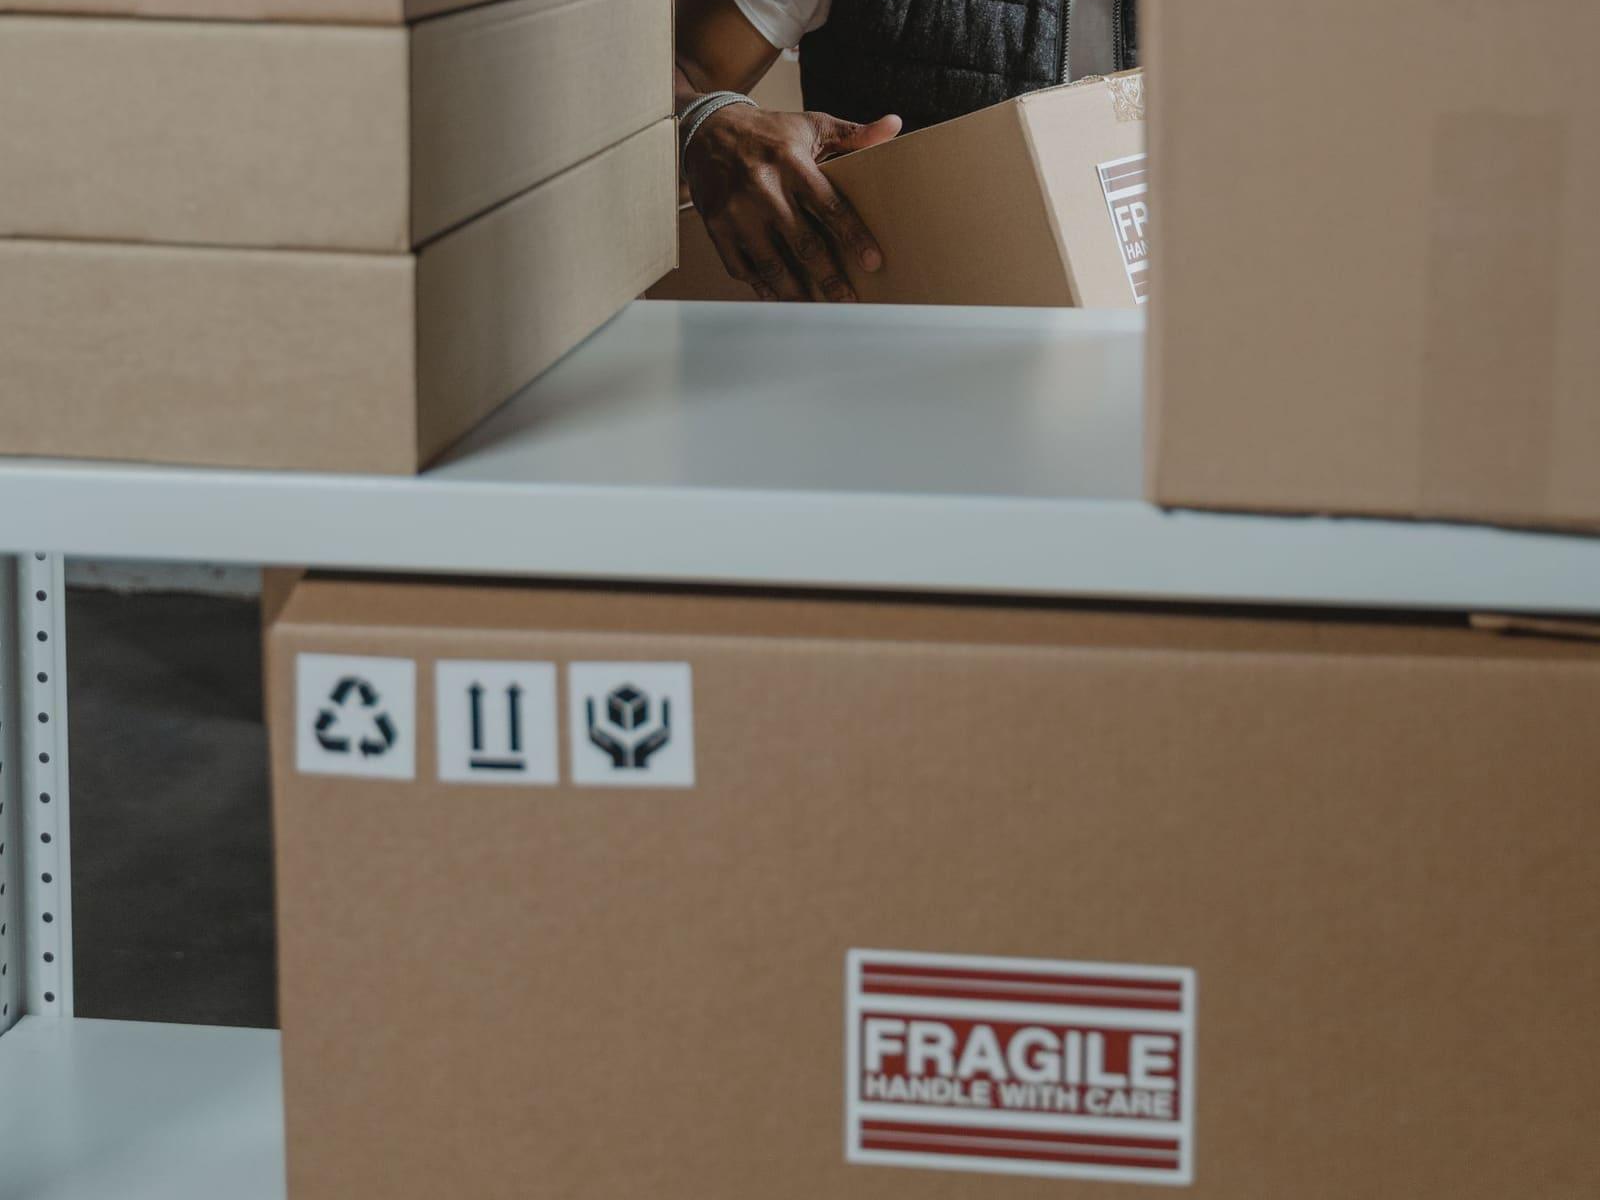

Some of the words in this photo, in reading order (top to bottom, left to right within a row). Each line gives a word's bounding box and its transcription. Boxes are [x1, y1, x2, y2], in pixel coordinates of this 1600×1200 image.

[864, 1017, 1176, 1090] FRAGILE
[866, 1073, 991, 1106] HANDLE
[1000, 1081, 1077, 1112] WITH
[1085, 1089, 1174, 1119] CARE
